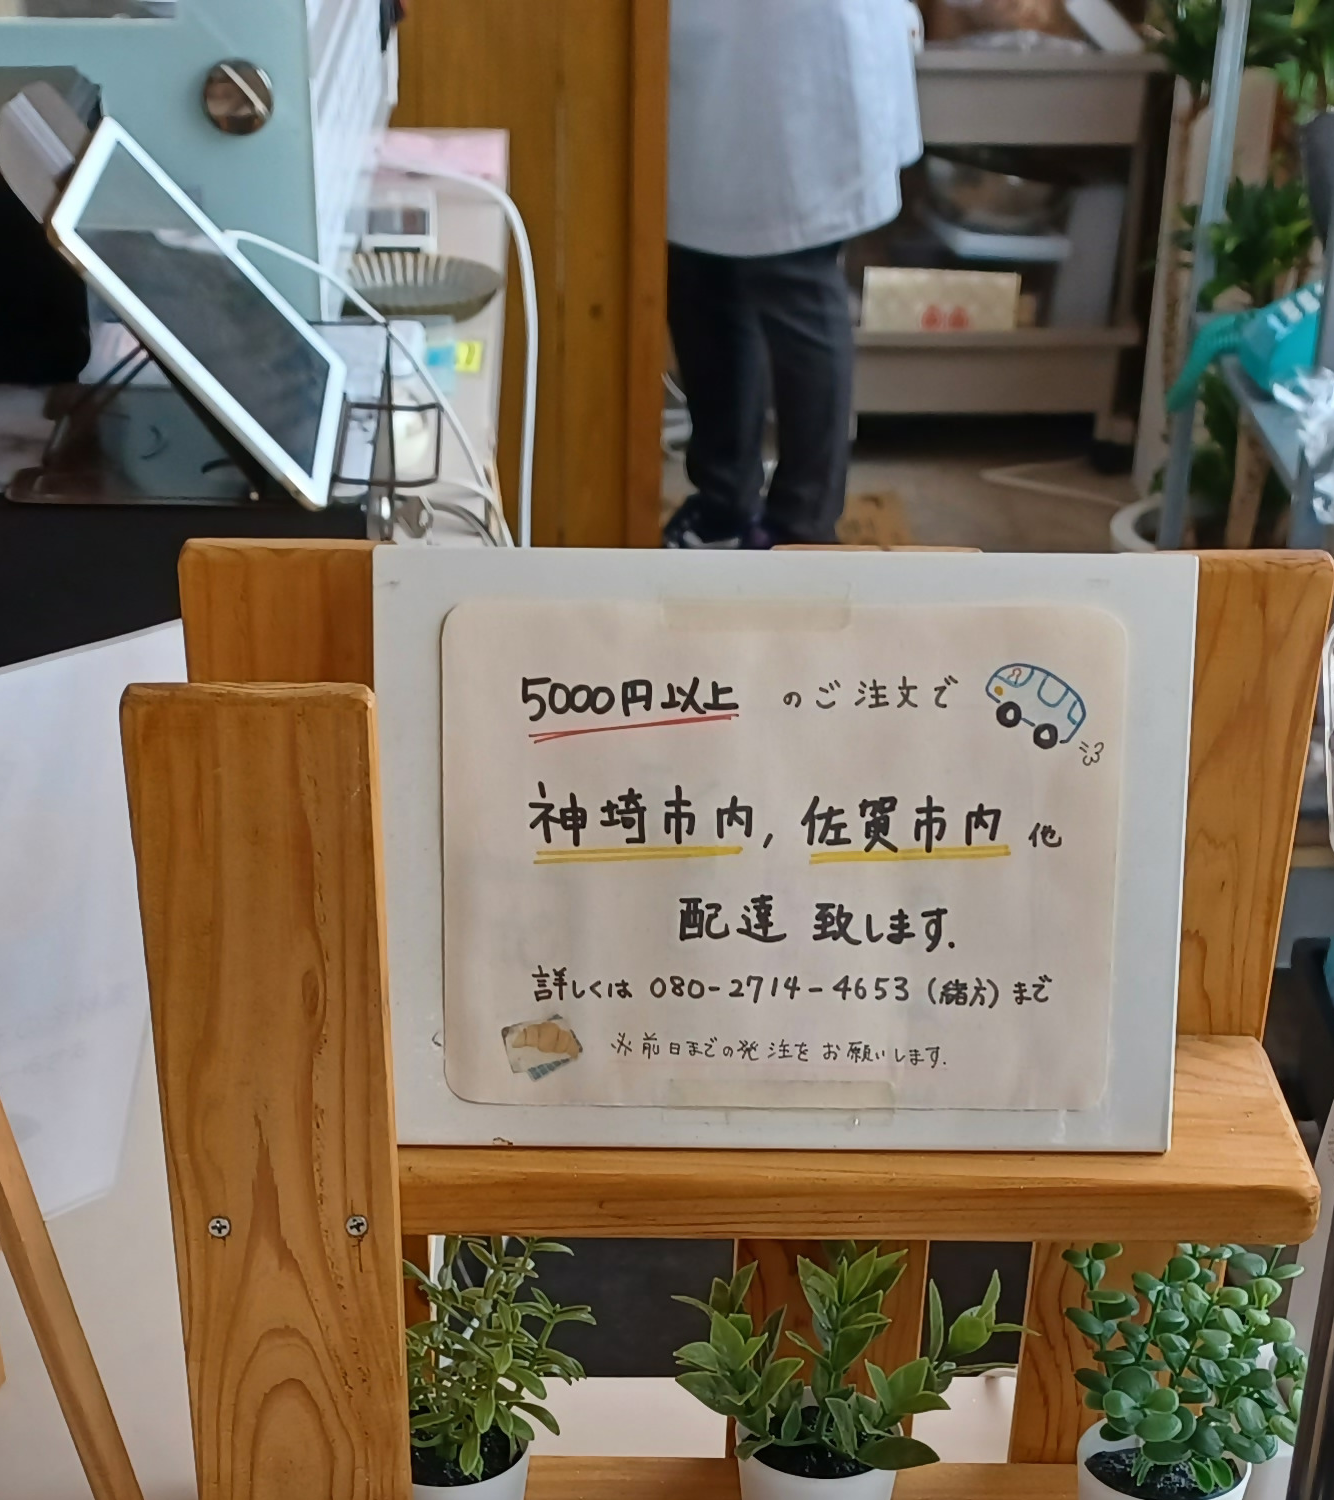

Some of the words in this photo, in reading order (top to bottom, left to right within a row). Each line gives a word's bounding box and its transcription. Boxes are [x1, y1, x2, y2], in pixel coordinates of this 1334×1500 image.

[520, 676, 740, 722] 5000円以上
[782, 675, 959, 710] のご注文で
[800, 795, 1003, 854] 佐賀市内
[1028, 822, 1063, 848] 他
[678, 893, 788, 945] 配達
[531, 964, 634, 1002] 詳しくは
[649, 974, 910, 1004] 080-2714-4653
[1012, 973, 1054, 1006] まで
